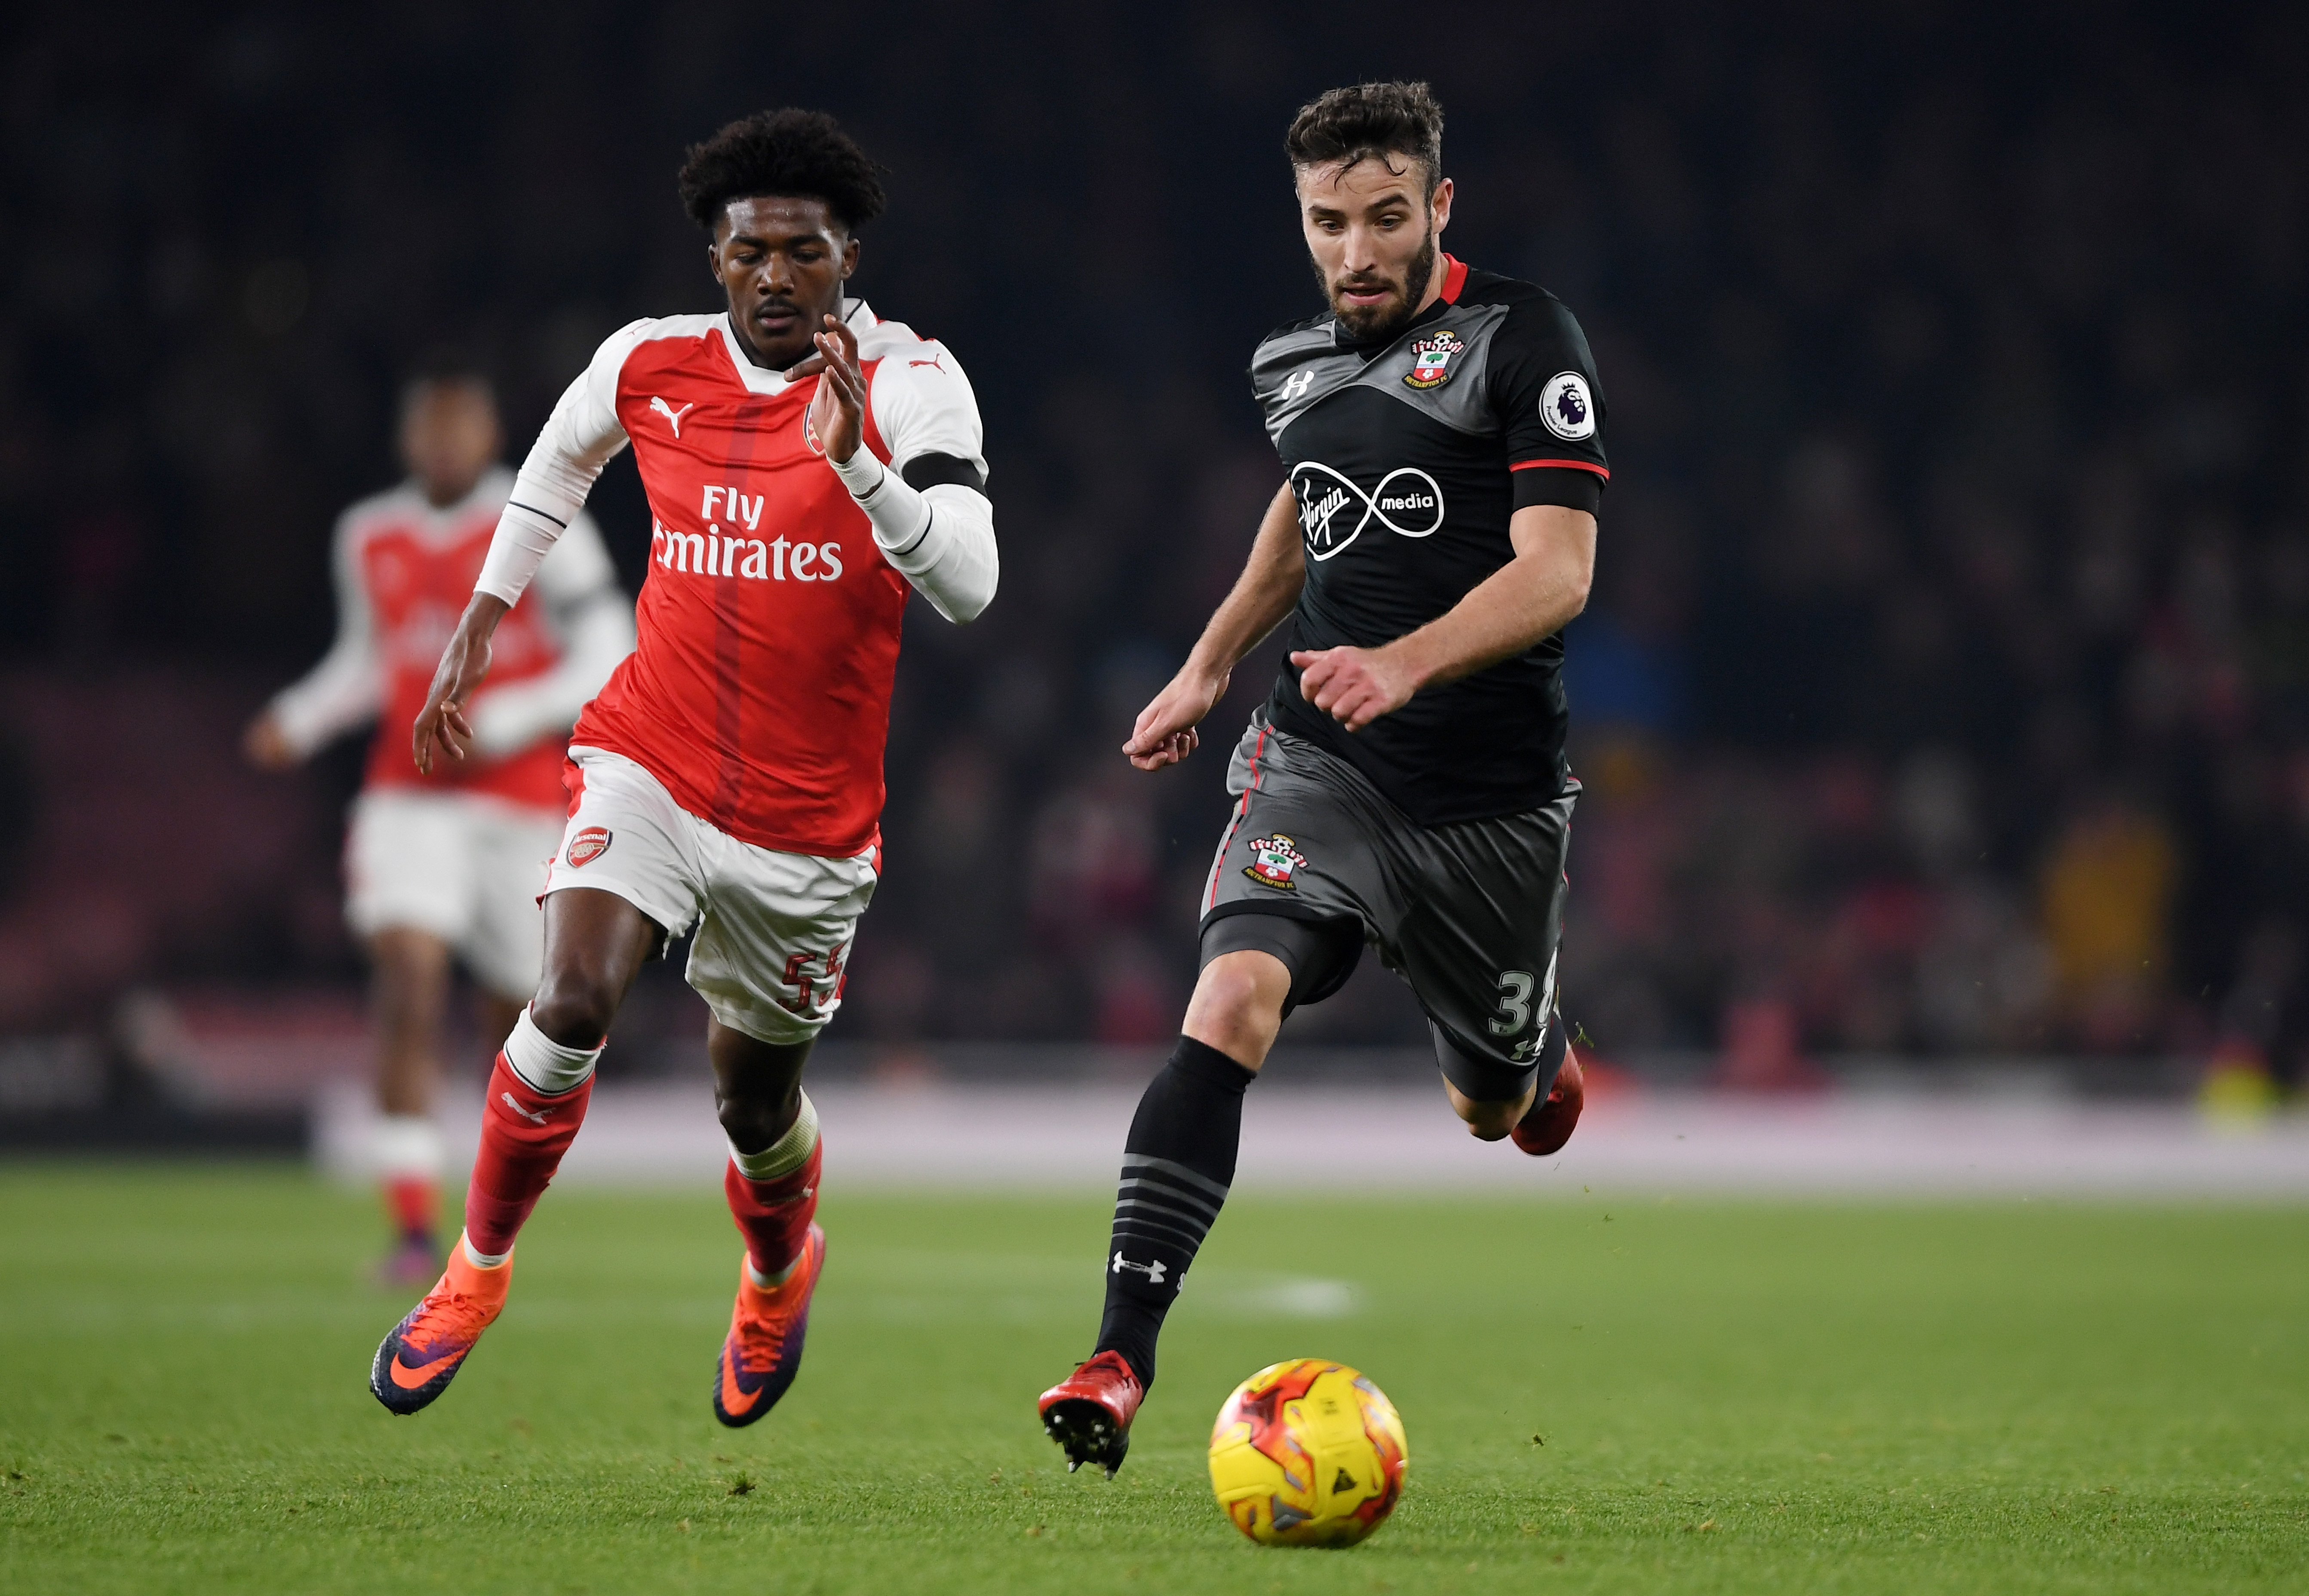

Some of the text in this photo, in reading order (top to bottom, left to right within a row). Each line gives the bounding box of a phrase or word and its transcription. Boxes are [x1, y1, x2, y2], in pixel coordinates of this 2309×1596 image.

[1404, 375, 1440, 388] SOUTHAMPTON
[1546, 405, 1578, 435] Premier League
[701, 485, 764, 530] Fly
[1298, 478, 1434, 546] Virgin media
[577, 833, 606, 842] Arsenal
[1245, 867, 1286, 888] SOUTHAMPTON
